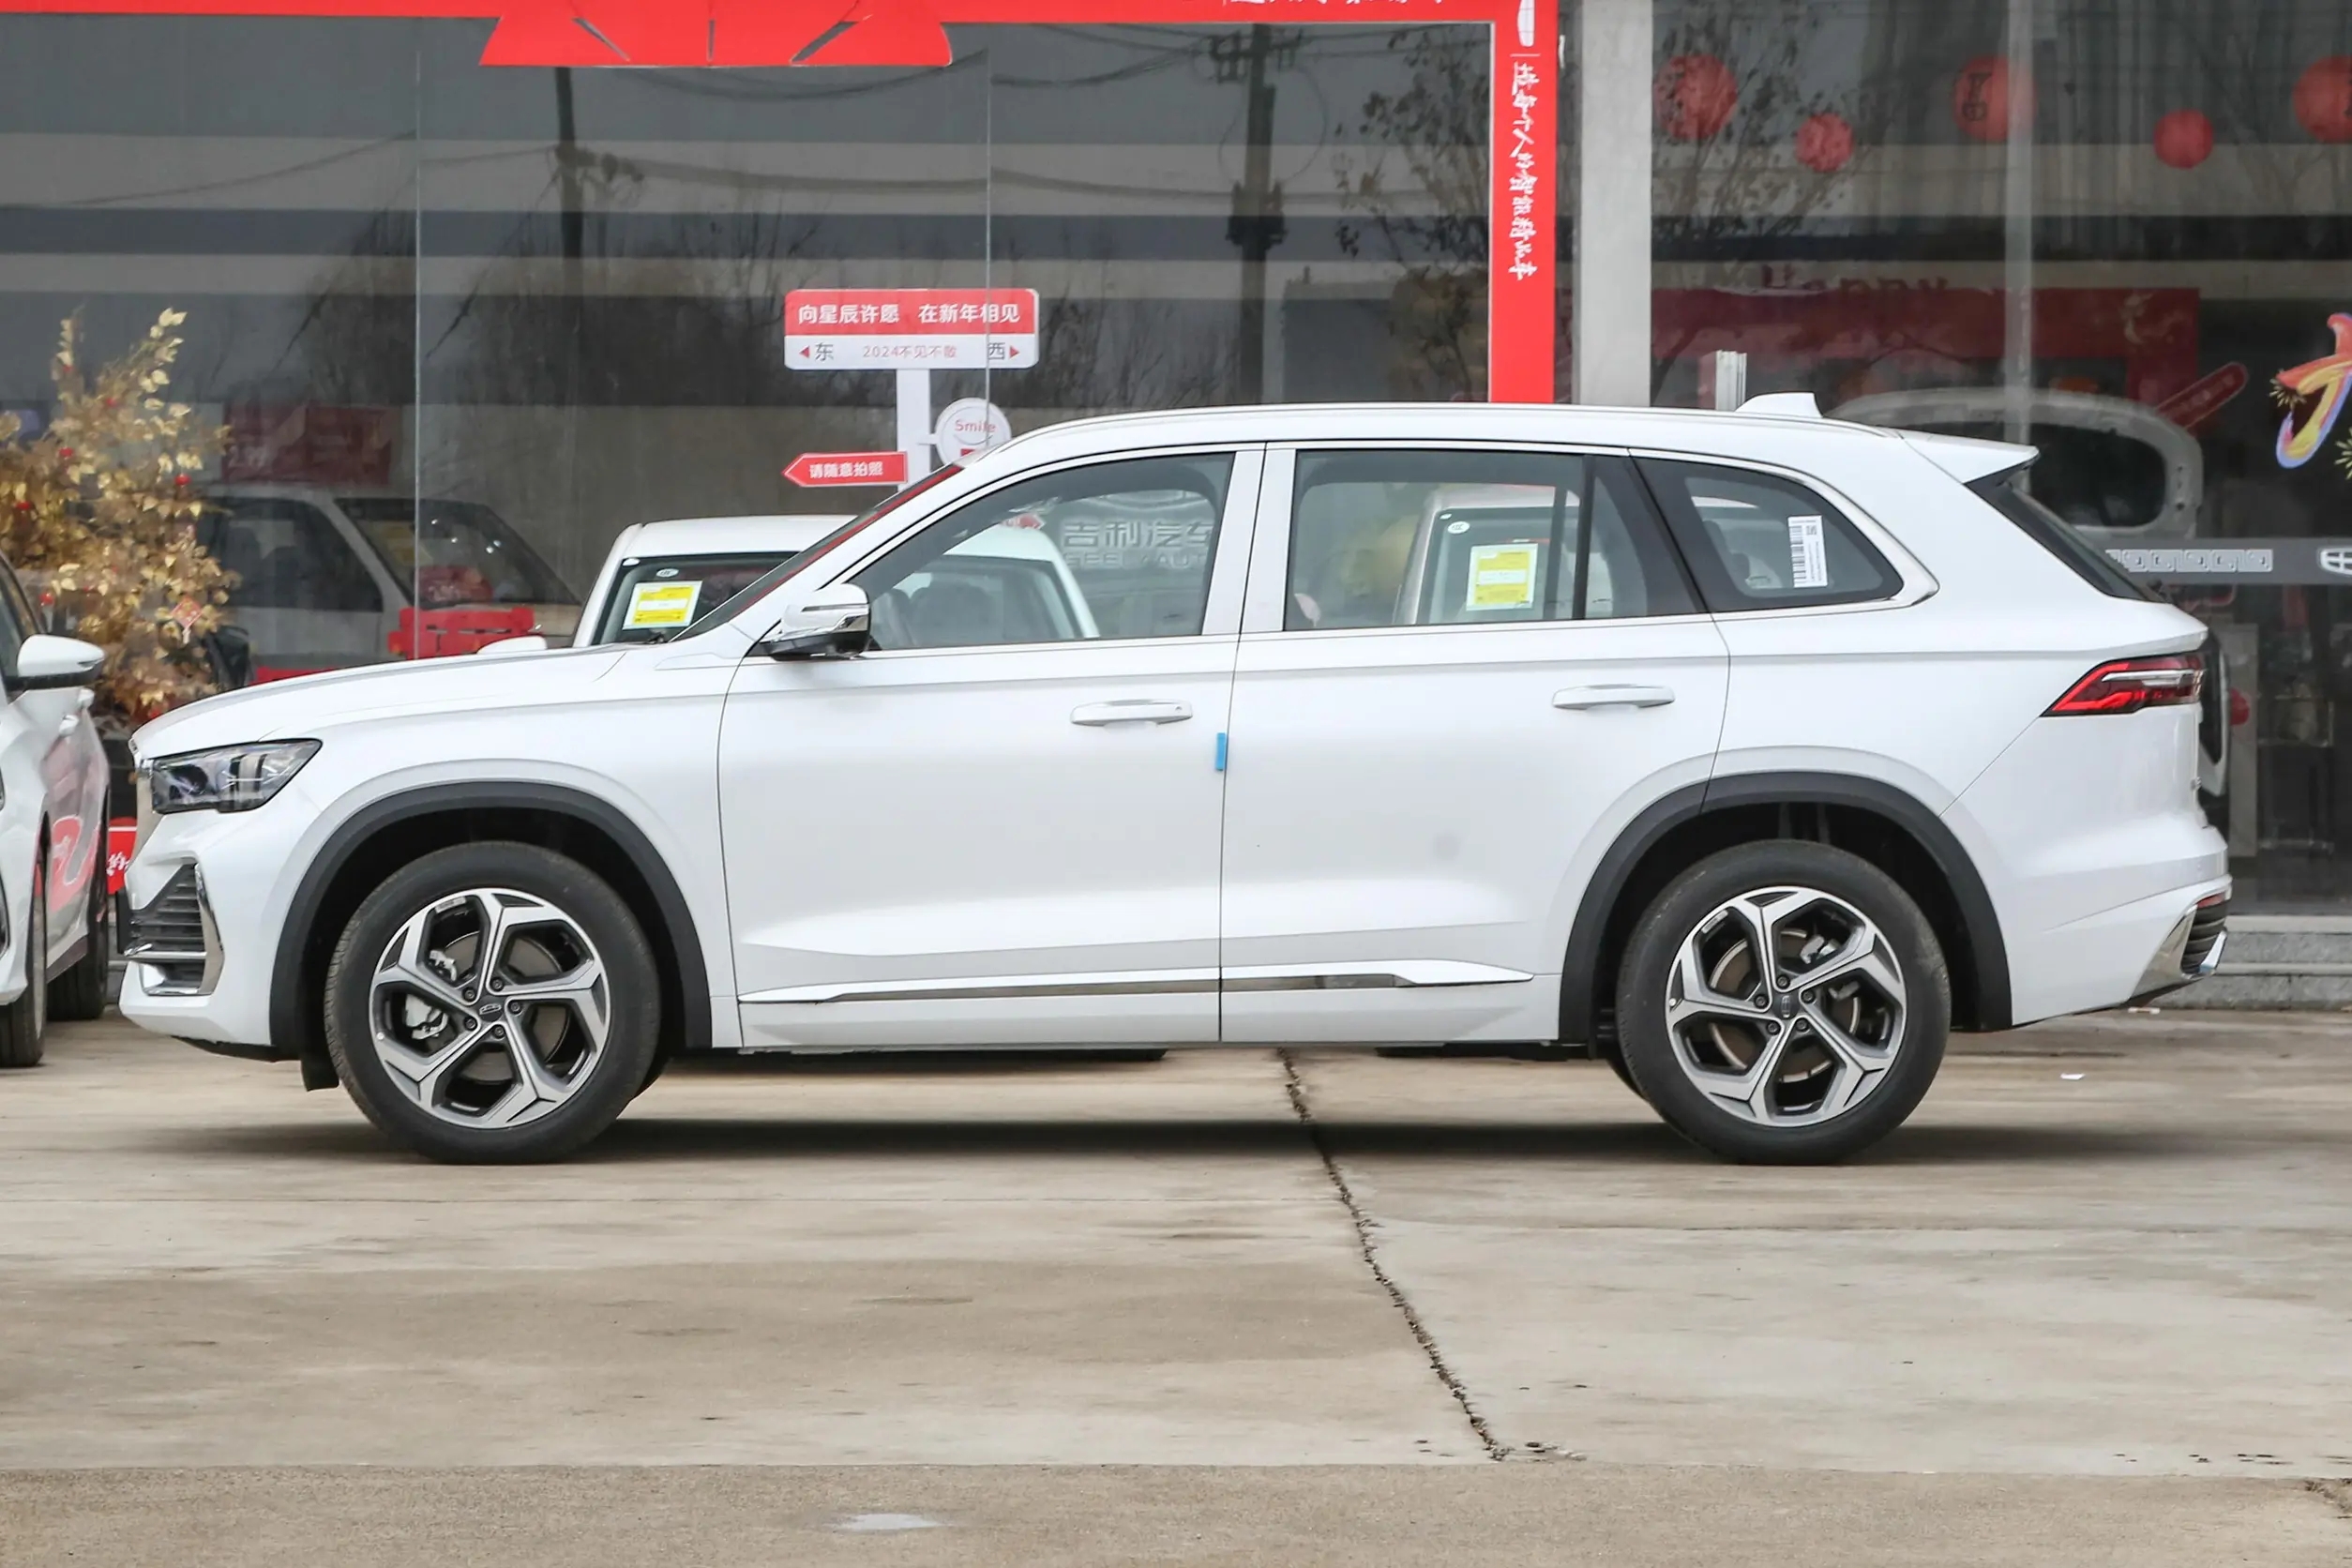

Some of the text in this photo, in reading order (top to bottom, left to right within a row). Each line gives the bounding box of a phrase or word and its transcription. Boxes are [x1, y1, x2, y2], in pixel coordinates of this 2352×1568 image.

[798, 303, 1021, 324] 向星辰许愿 在新年相见
[814, 342, 835, 362] 东
[862, 344, 958, 360] 2024不见不散
[988, 342, 1006, 361] 西
[955, 419, 996, 433] Smile
[808, 461, 884, 479] 请随意拍照
